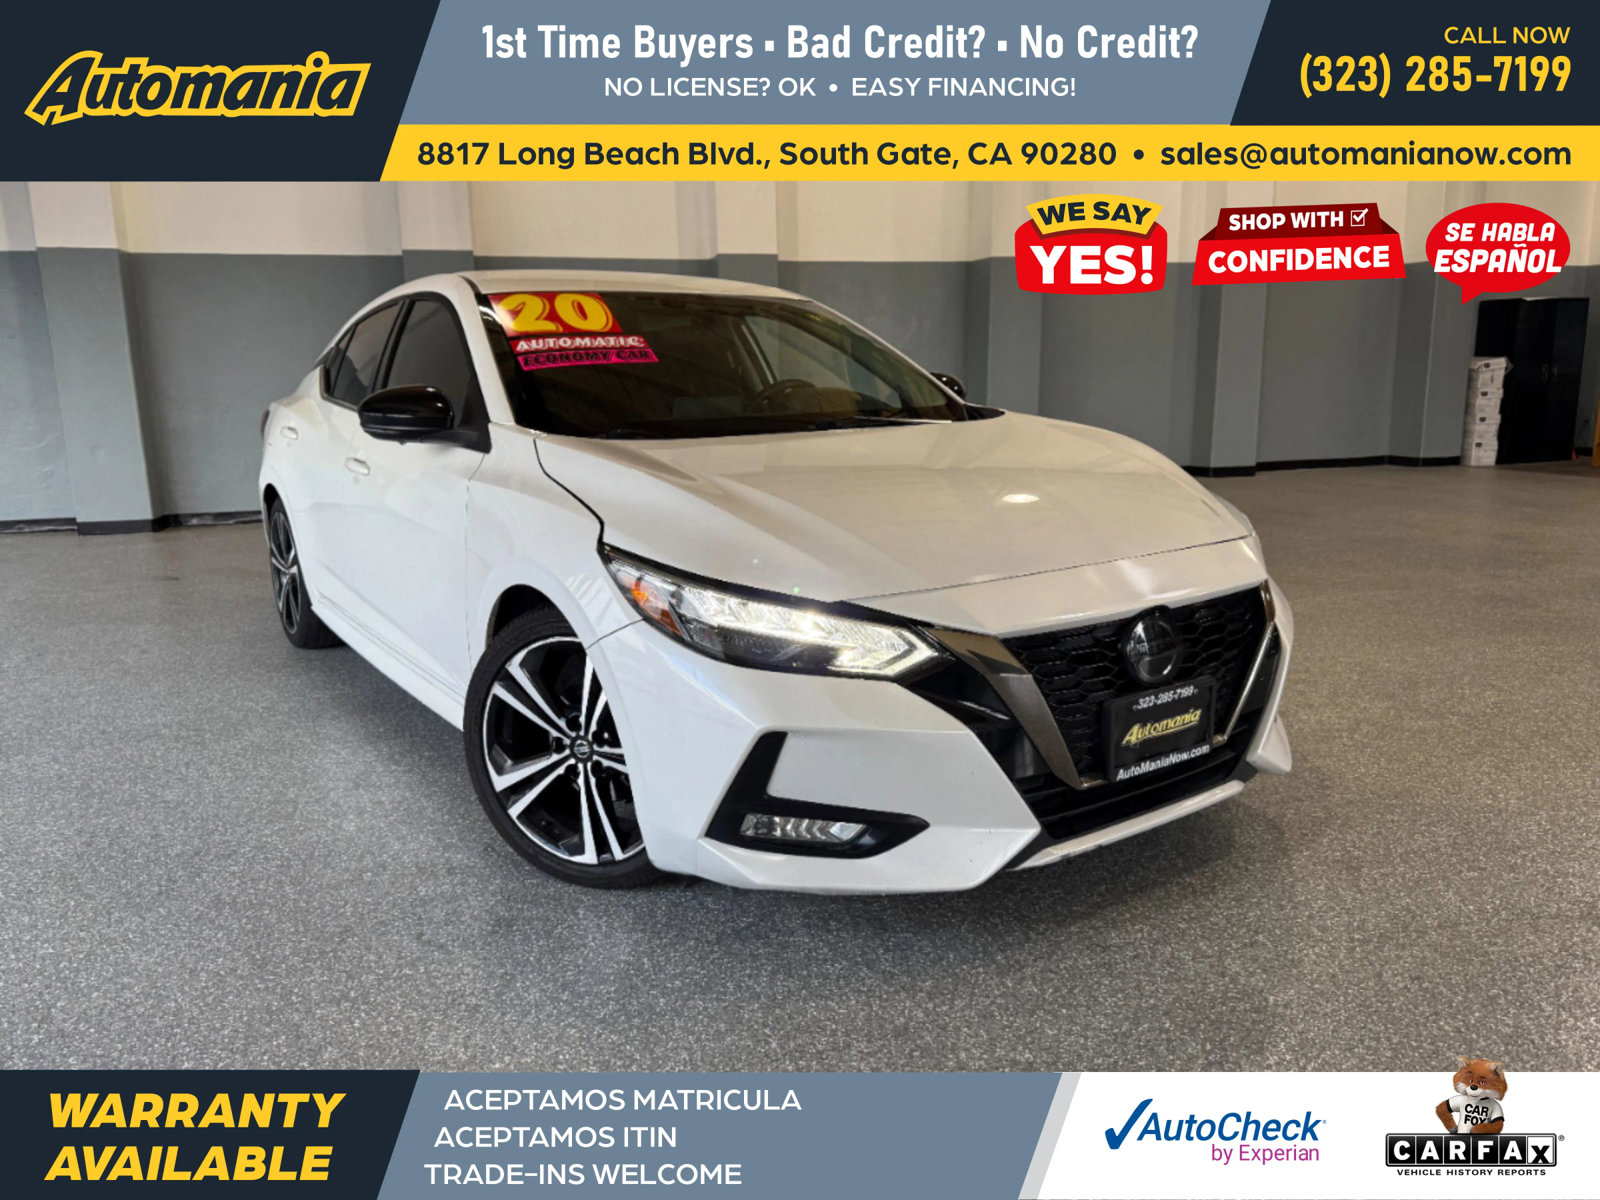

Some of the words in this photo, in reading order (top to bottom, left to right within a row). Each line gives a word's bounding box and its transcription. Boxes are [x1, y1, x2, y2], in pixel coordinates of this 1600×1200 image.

[500, 293, 613, 332] 20
[516, 336, 646, 351] AUTOMATIC
[523, 351, 610, 367] ECONOMY
[615, 350, 651, 361] CAR
[1121, 709, 1202, 746] Automania
[1116, 744, 1210, 781] AutoManiaNow.com
